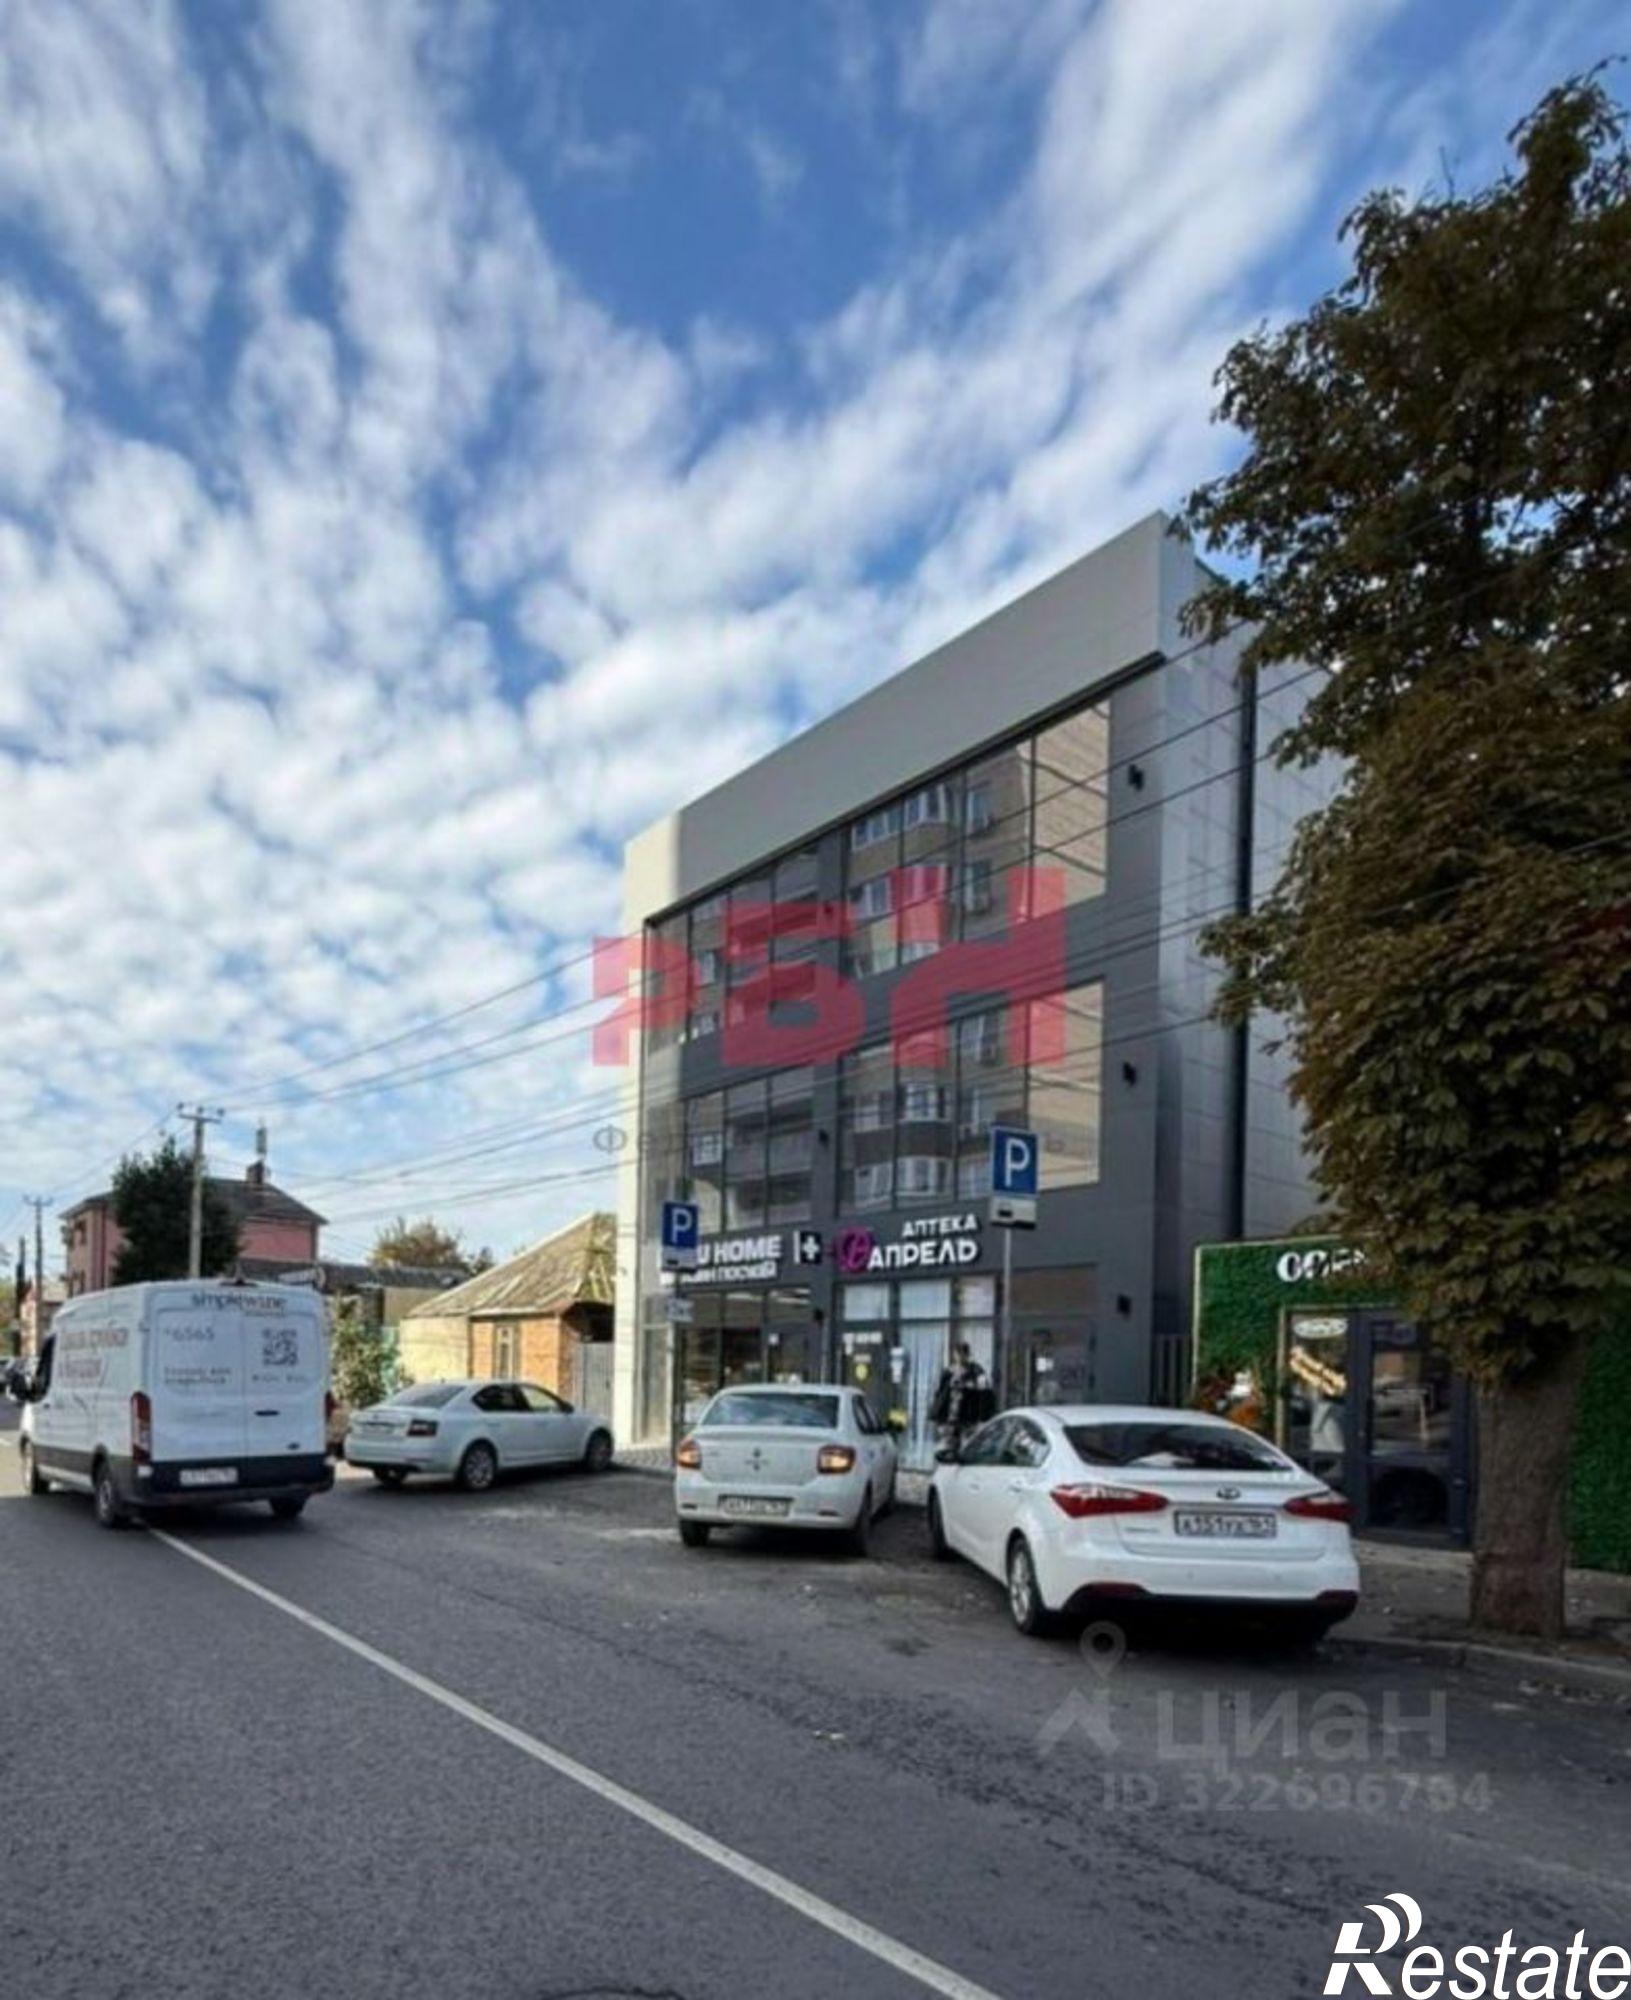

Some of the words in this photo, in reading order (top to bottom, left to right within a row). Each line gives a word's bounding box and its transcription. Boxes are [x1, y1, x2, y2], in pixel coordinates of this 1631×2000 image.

[1004, 1137, 1031, 1188] P
[671, 1207, 693, 1242] P
[901, 1213, 978, 1237] АПТЕКА
[713, 1234, 783, 1264] HOME
